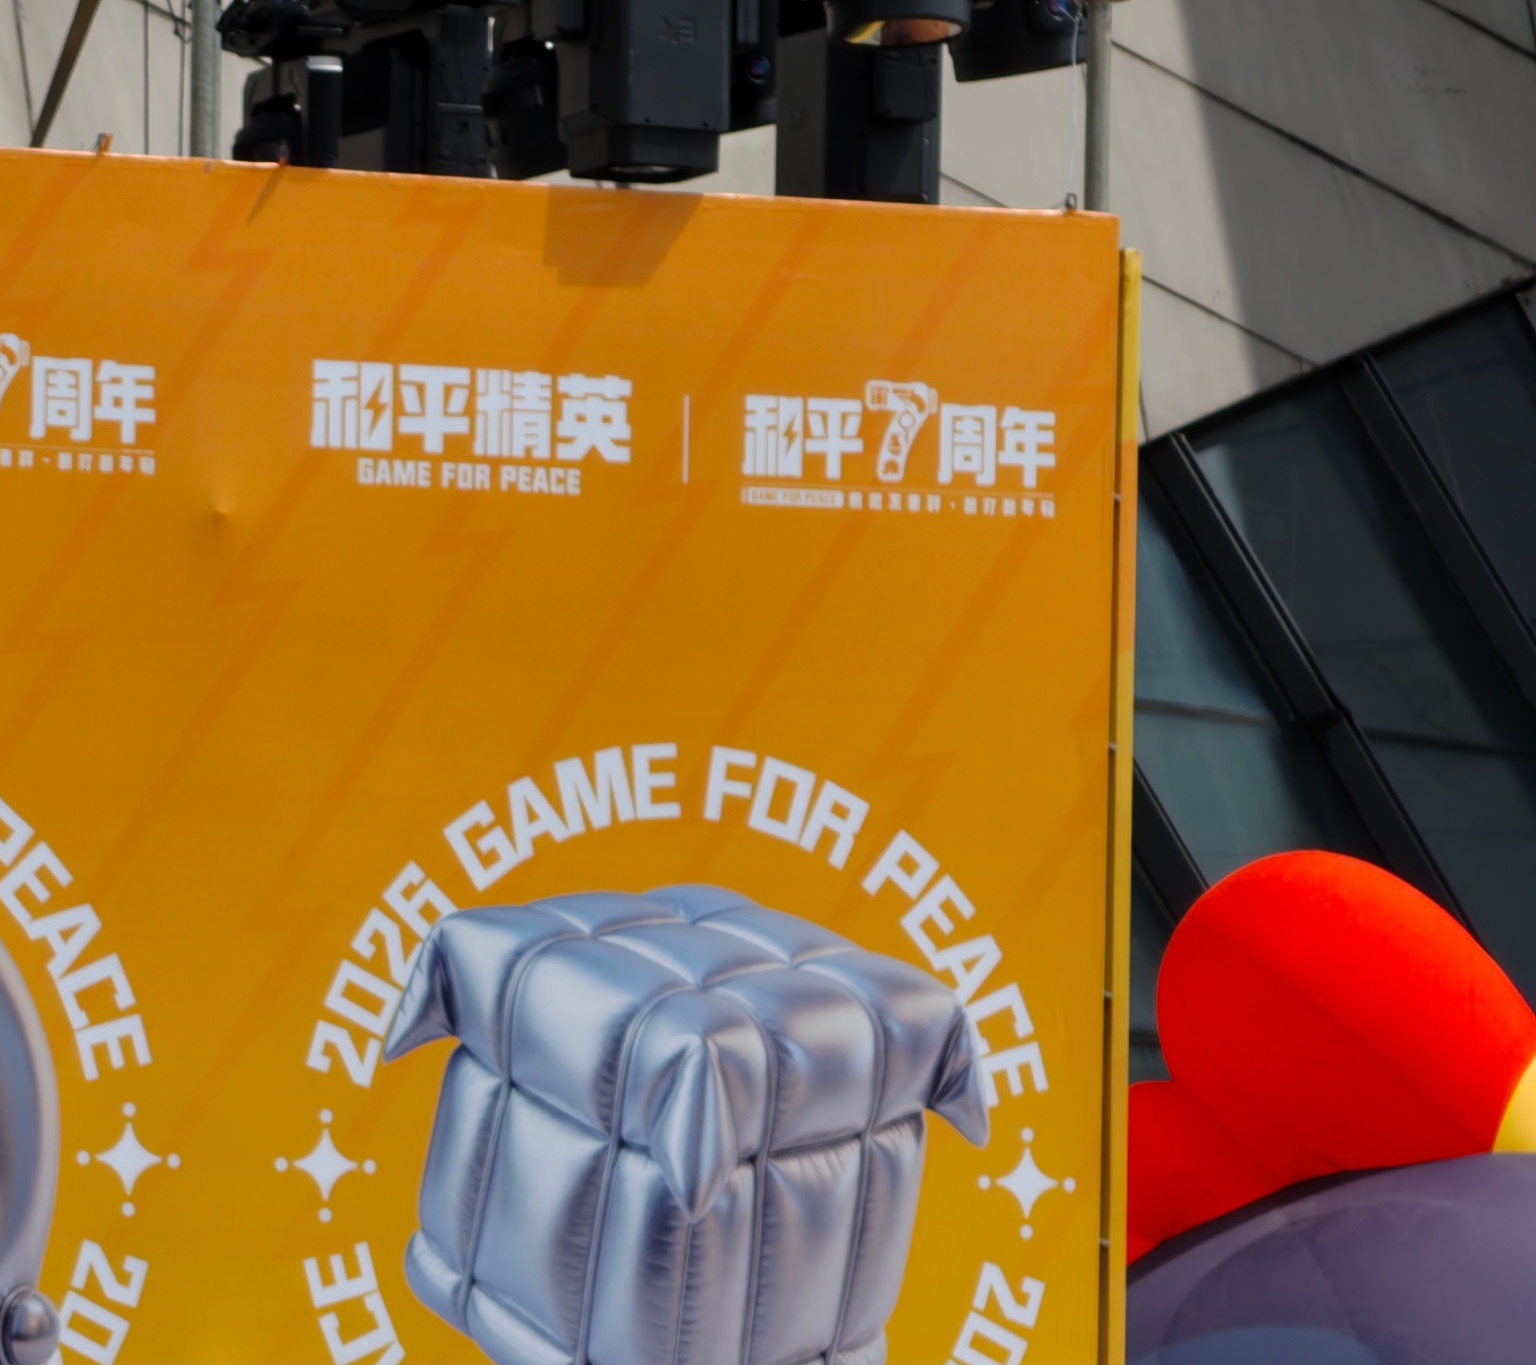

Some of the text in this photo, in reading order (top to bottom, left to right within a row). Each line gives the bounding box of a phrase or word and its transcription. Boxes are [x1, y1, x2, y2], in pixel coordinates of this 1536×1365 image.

[311, 359, 632, 463] 和平精英
[741, 379, 1057, 488] 和平7周年
[357, 457, 582, 495] GAME FOR PEACE
[306, 742, 1049, 1108] 2026 GAME FOR PEACE
